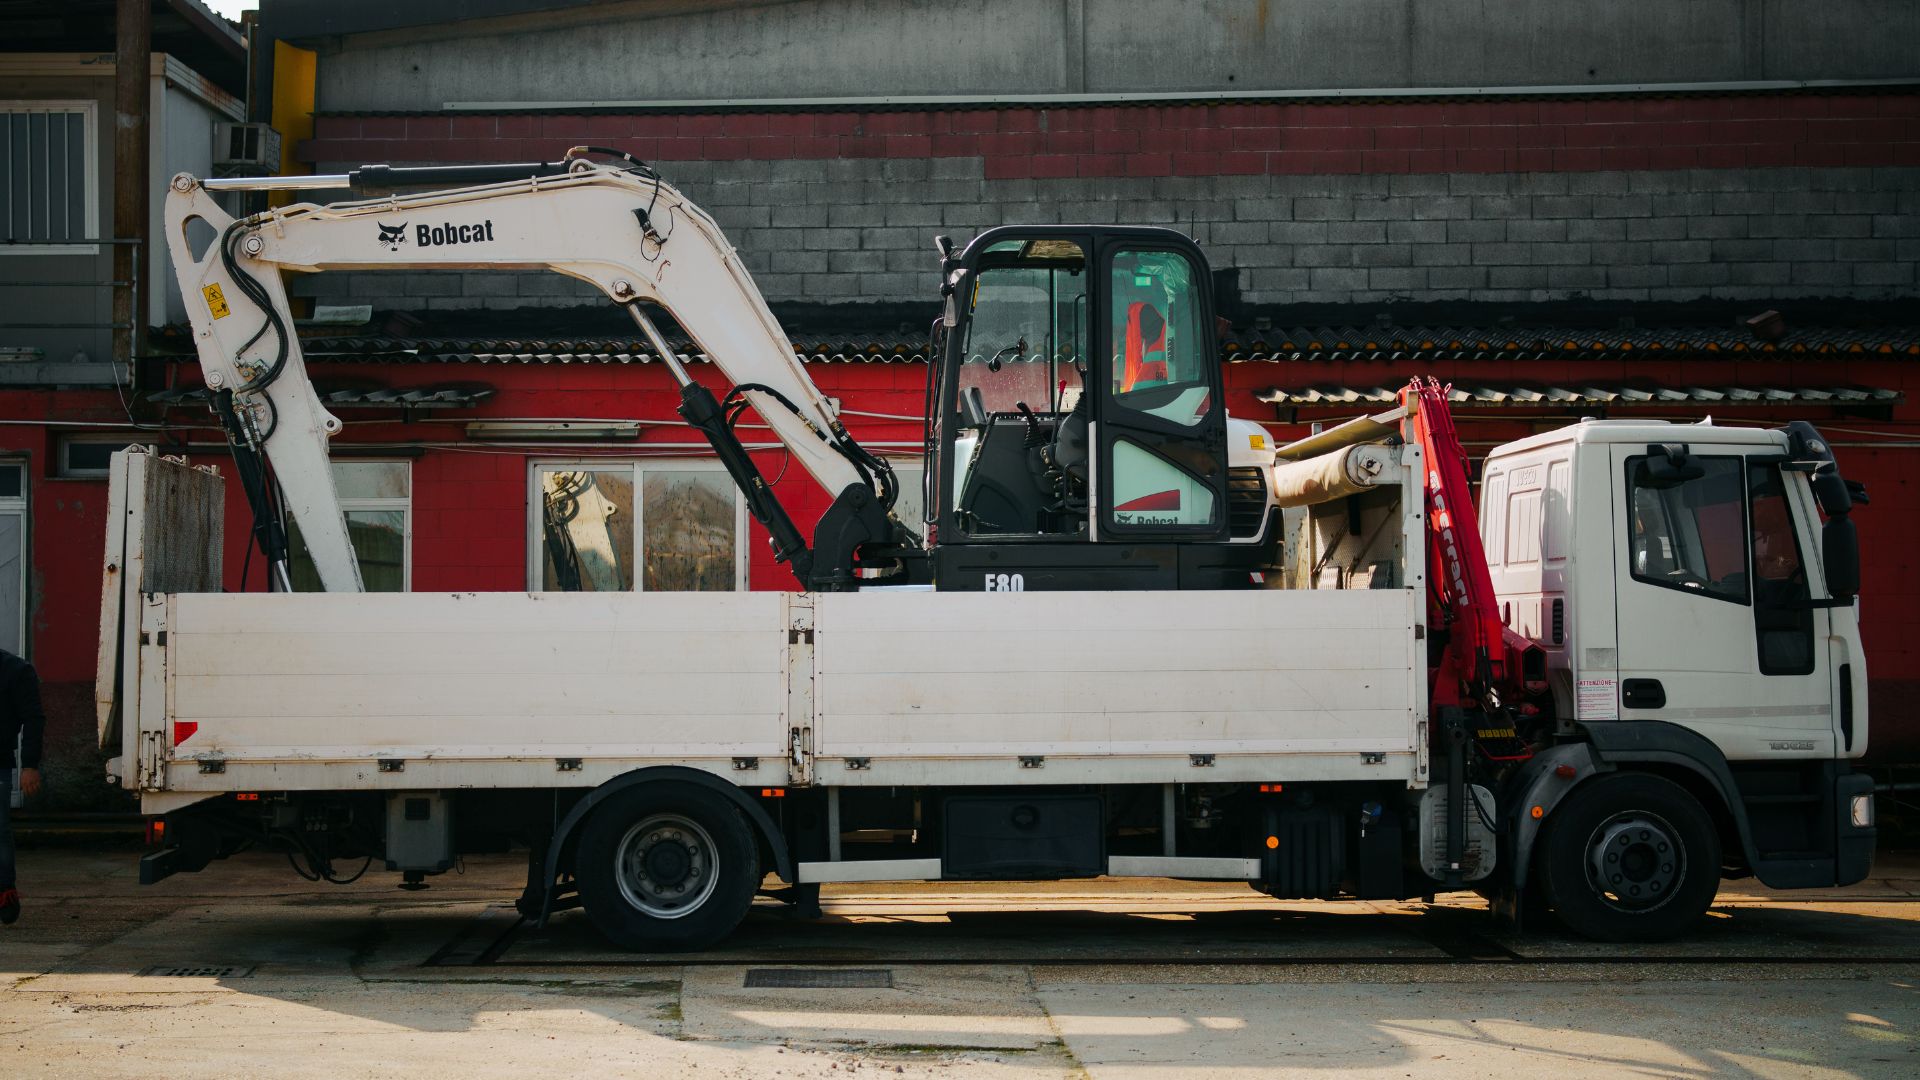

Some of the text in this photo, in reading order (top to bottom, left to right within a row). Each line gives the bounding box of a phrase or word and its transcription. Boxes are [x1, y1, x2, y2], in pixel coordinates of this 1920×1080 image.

[416, 219, 494, 247] Bobcat
[1137, 515, 1179, 525] Bobcat
[985, 573, 1024, 592] E80
